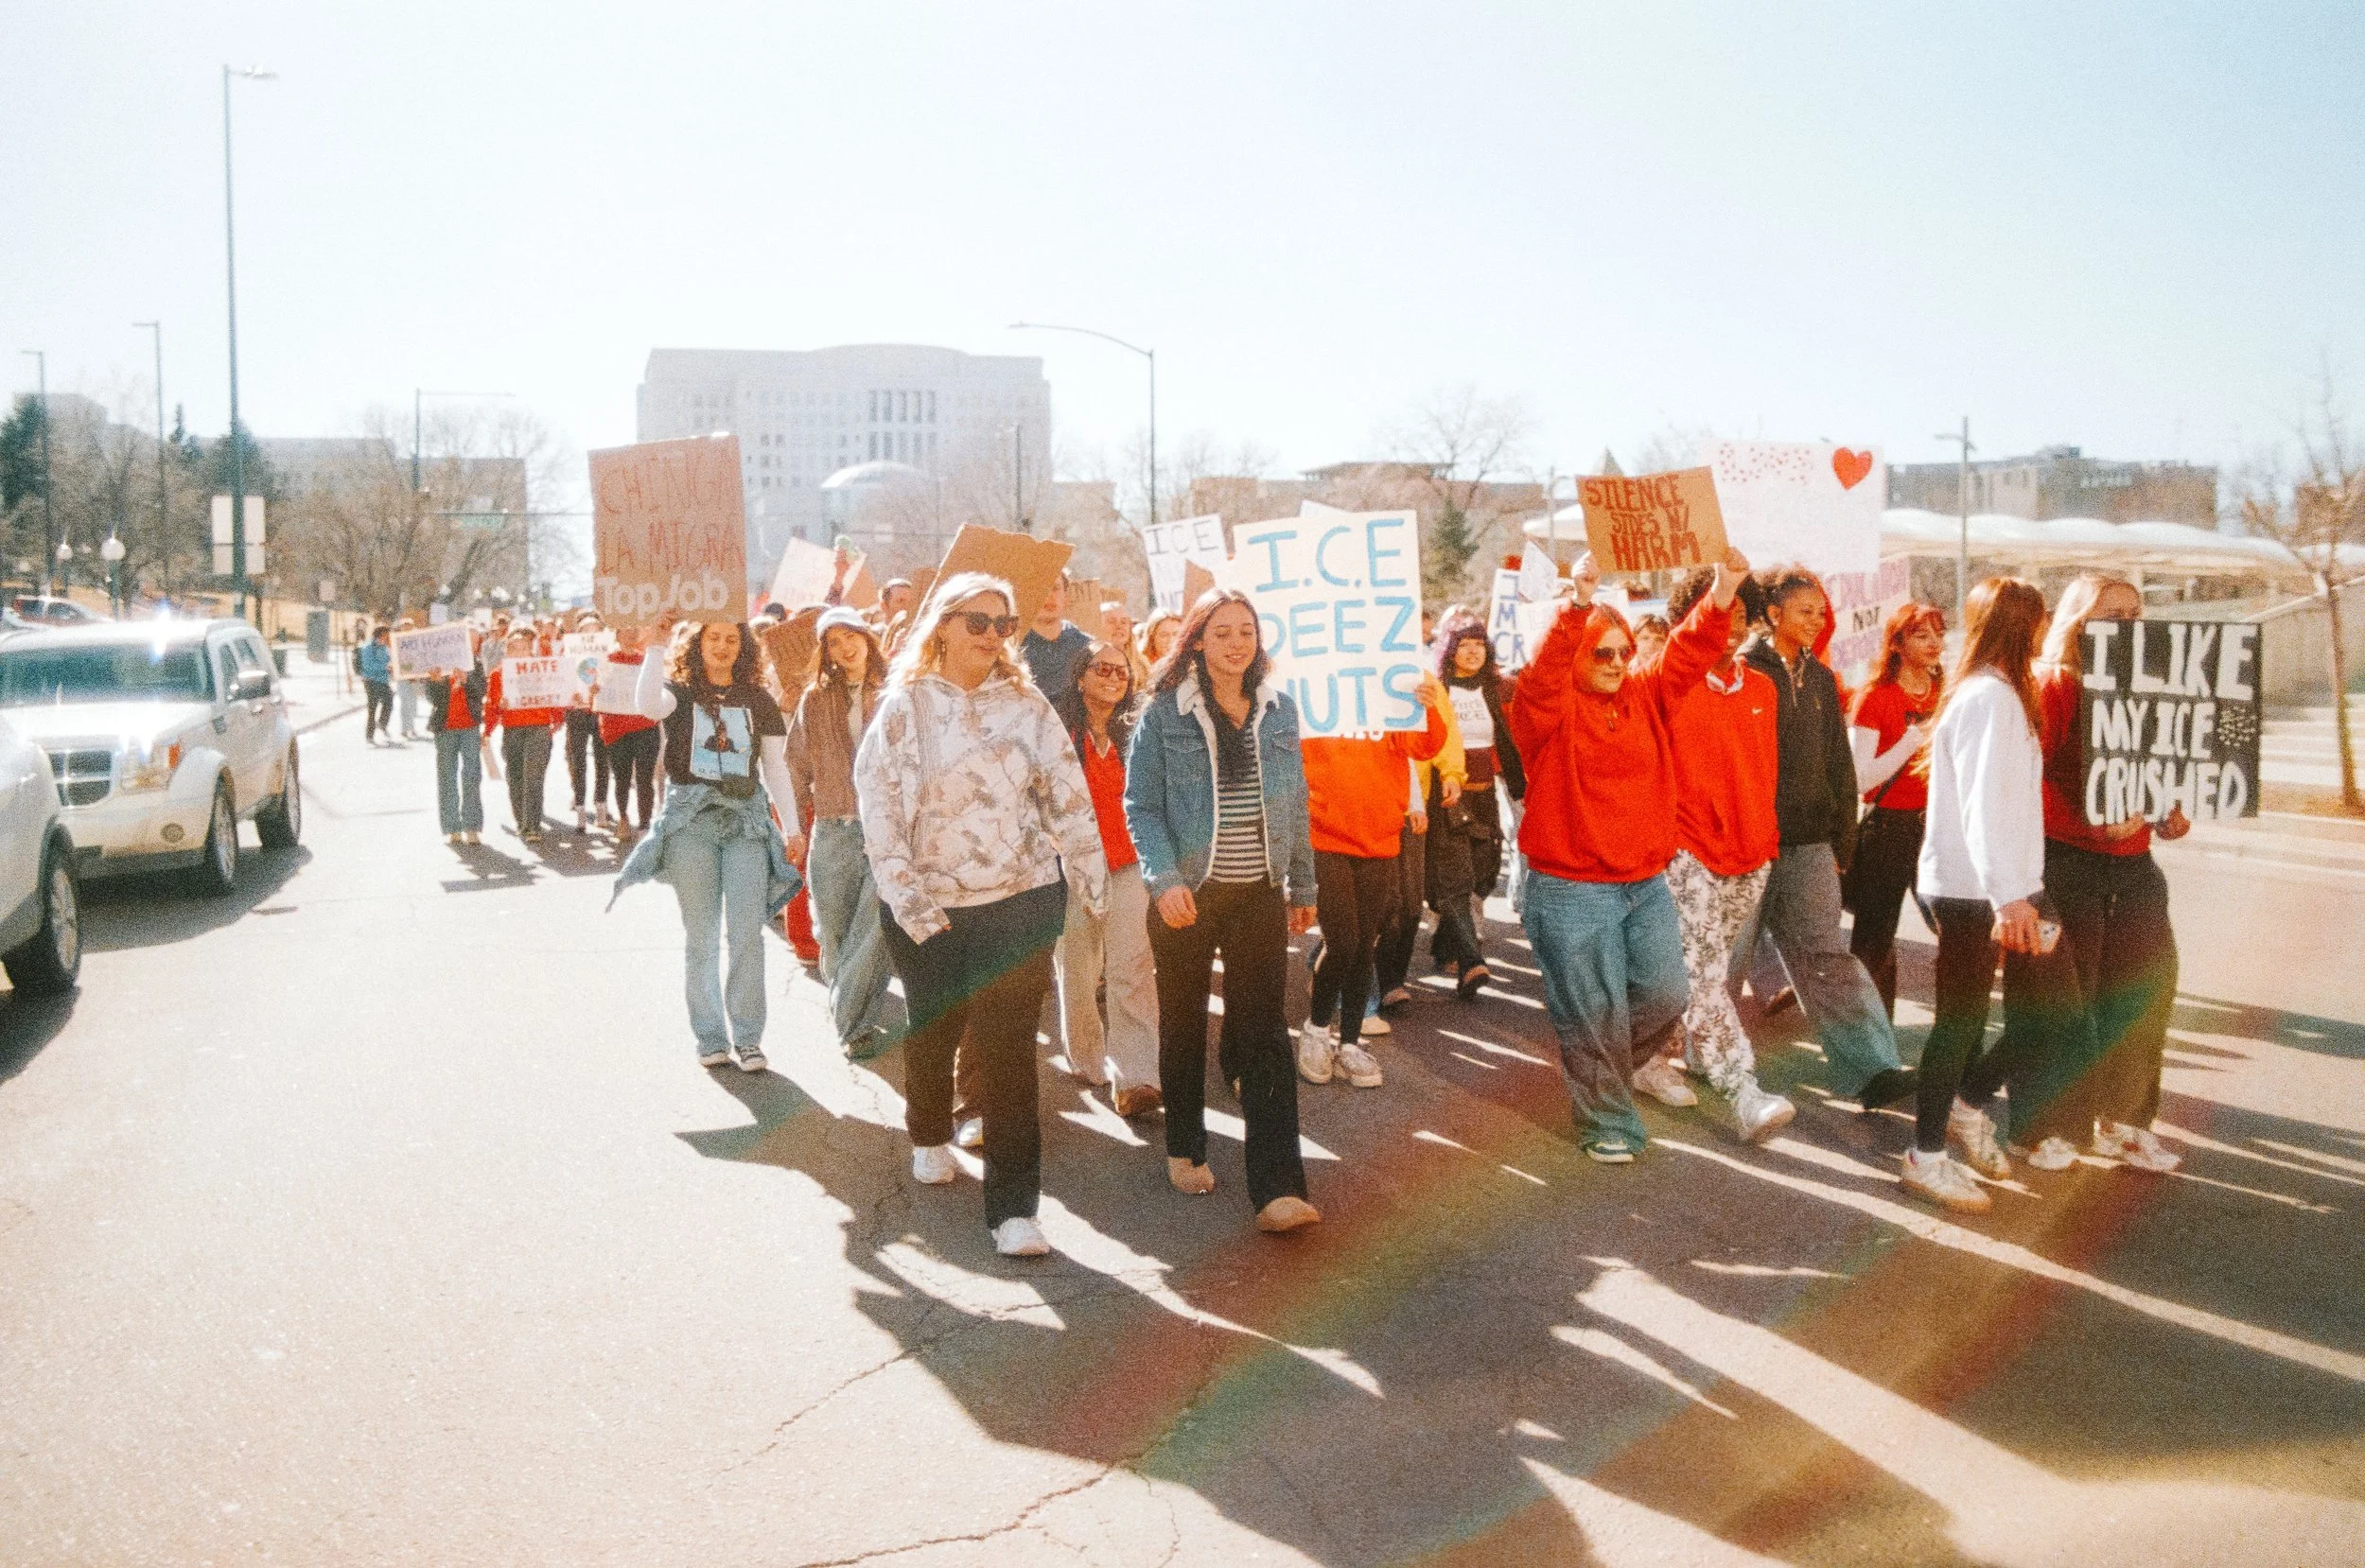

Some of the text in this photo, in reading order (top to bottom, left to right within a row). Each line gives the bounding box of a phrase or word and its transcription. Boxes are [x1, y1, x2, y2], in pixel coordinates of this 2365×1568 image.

[1584, 473, 1685, 512] SILENCE
[1145, 519, 1218, 556] ICE
[1611, 511, 1660, 535] SIDES
[601, 527, 638, 575] LA
[647, 520, 745, 576] MIGRA
[1610, 530, 1702, 572] HARM
[1852, 605, 1881, 633] NOT
[516, 659, 559, 675] HATE
[2082, 620, 2258, 701] I LIKE
[2092, 699, 2216, 758] MY ICE
[2084, 757, 2248, 827] CRUSHED
